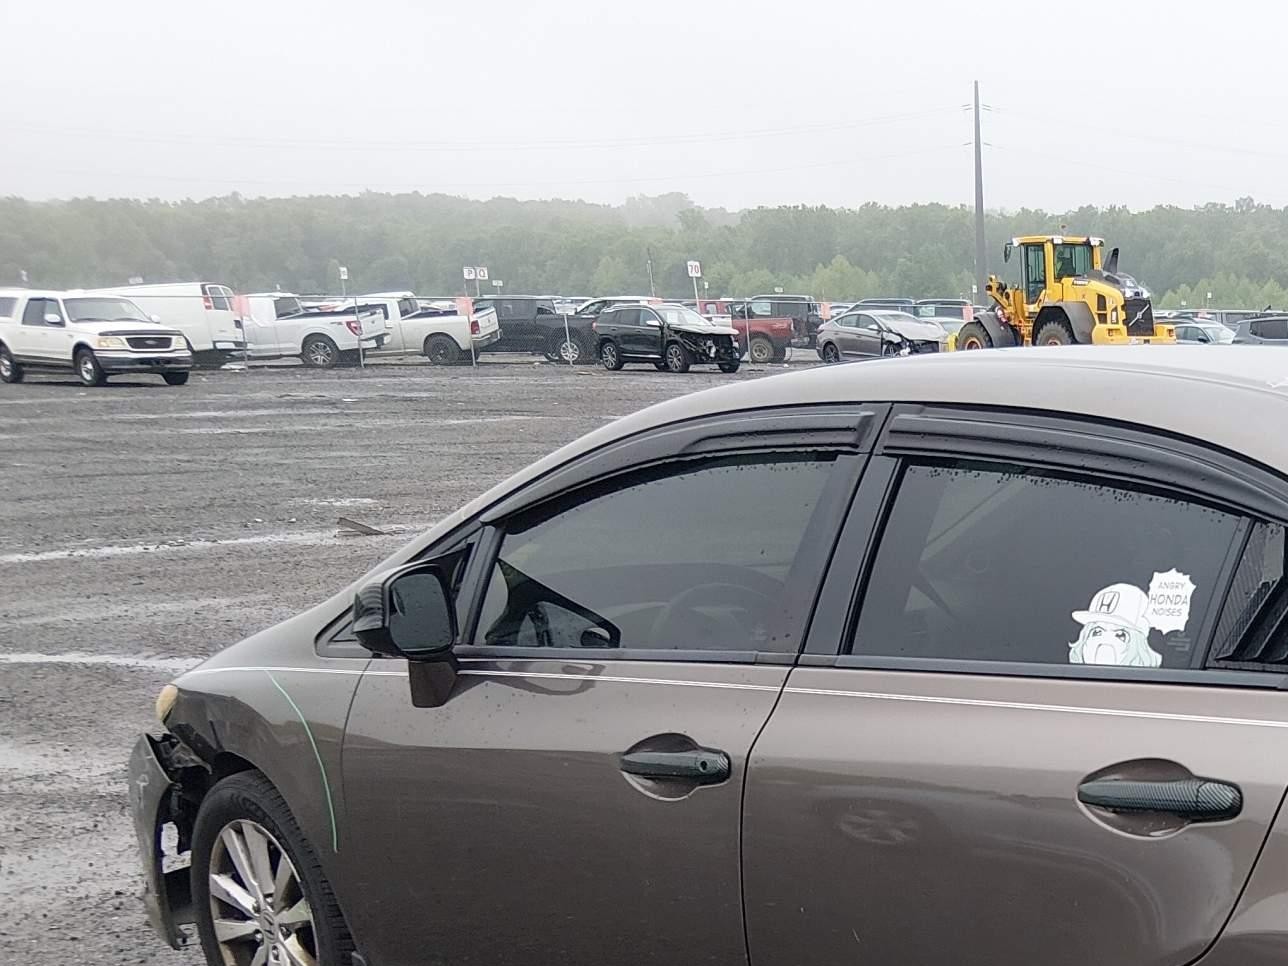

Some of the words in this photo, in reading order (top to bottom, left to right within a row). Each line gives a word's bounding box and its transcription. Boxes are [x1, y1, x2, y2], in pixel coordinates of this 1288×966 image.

[689, 264, 700, 274] 70
[1158, 581, 1186, 590] ANGRY
[1150, 594, 1188, 606] HONDA
[1151, 607, 1183, 617] NOISES
